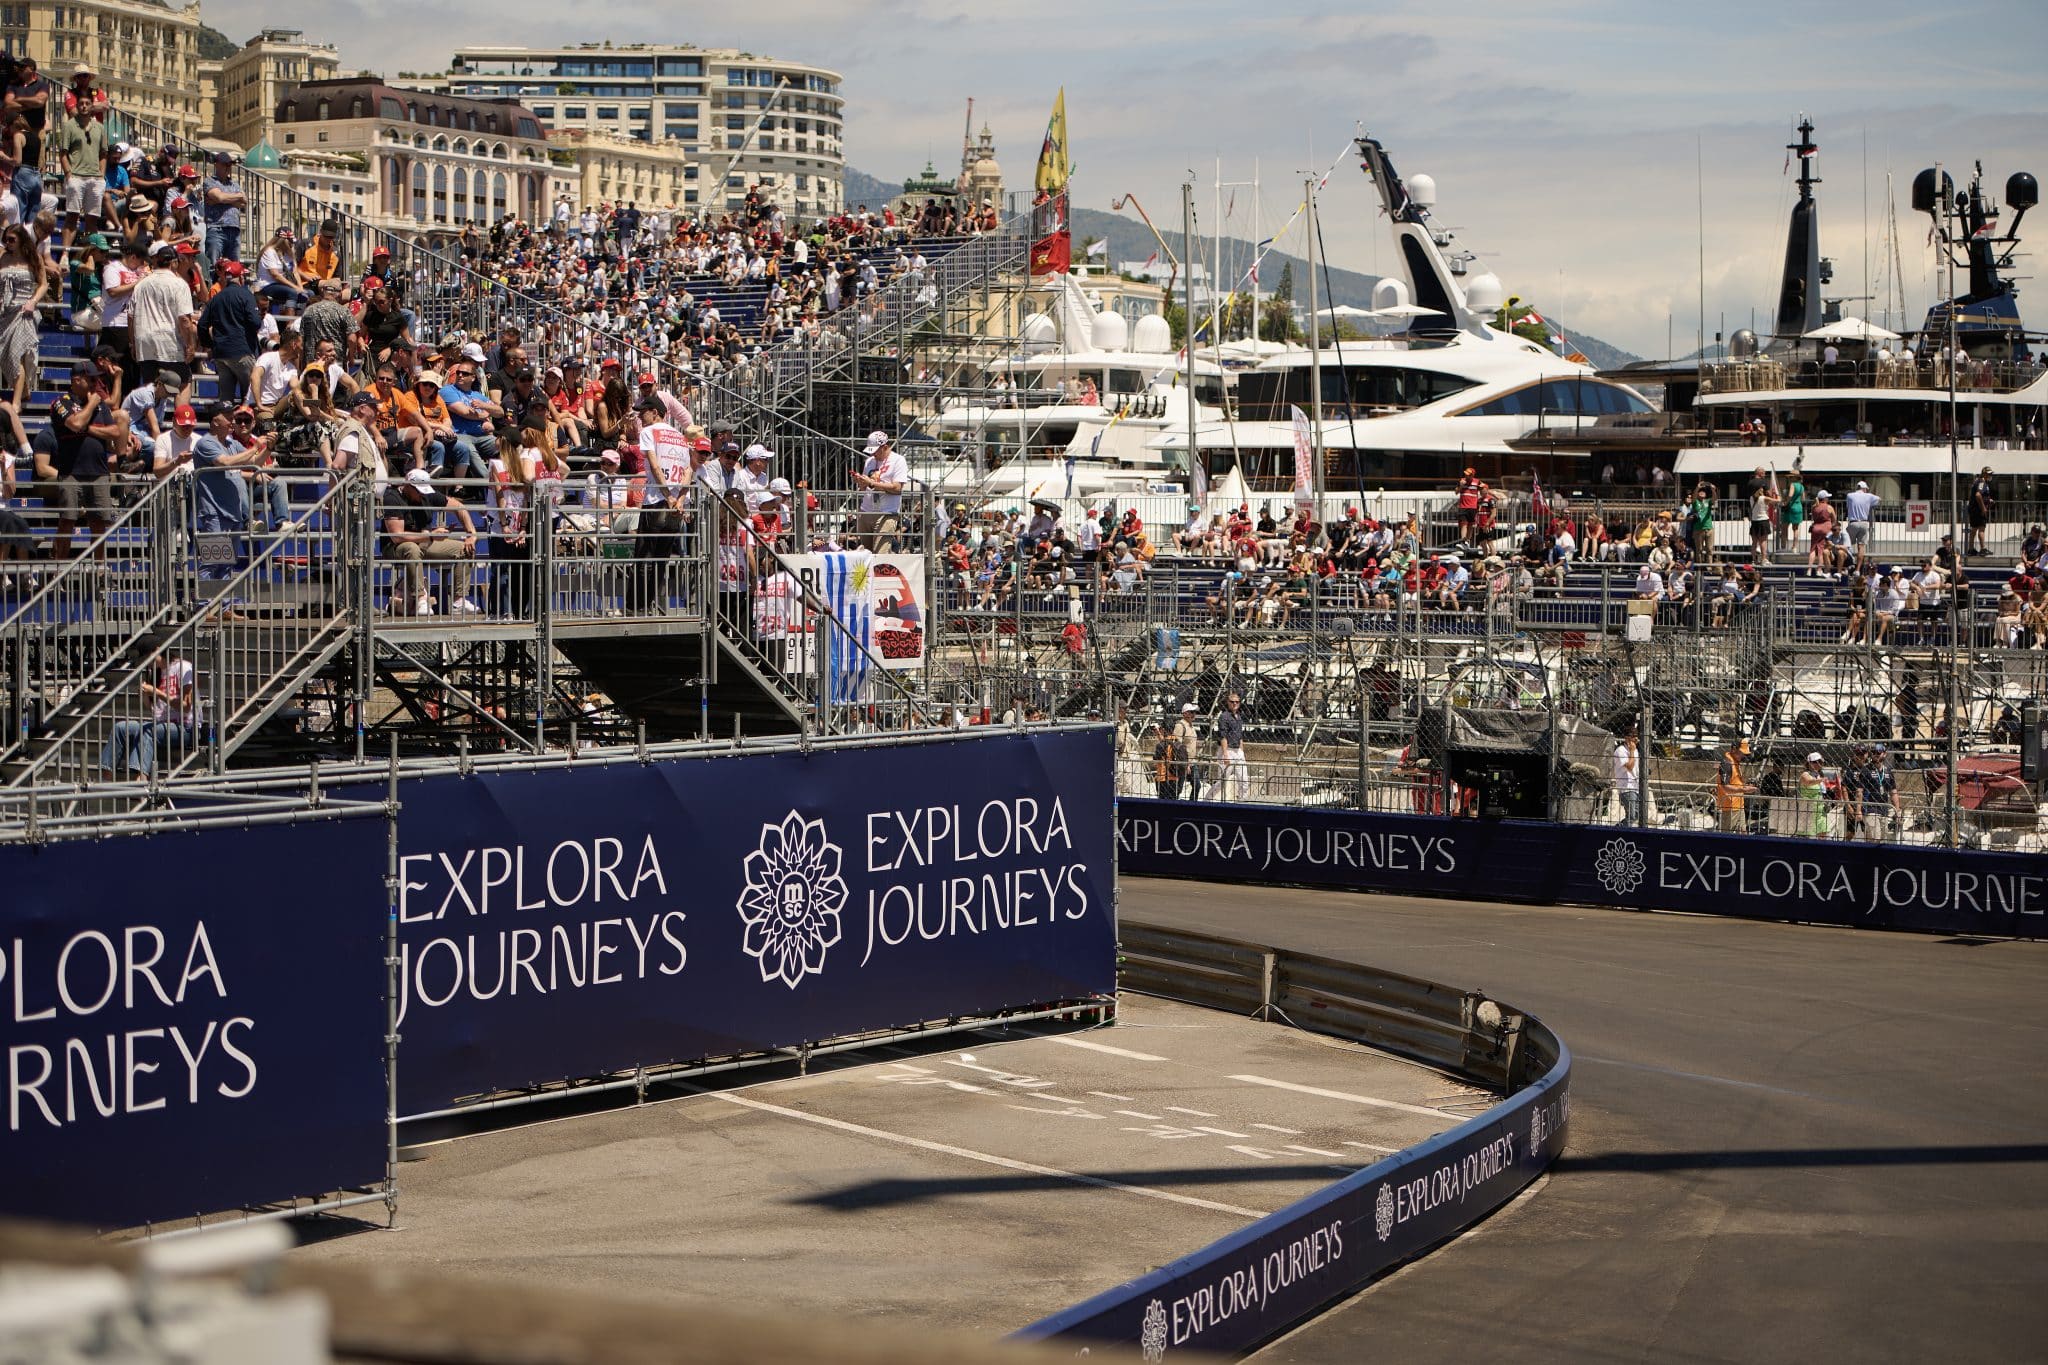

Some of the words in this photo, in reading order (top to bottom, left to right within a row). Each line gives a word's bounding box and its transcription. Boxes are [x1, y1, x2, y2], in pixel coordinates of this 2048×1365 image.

[1911, 513, 1925, 529] P
[400, 834, 667, 923] EXPLORA
[867, 795, 1072, 873] EXPLORA
[1261, 826, 1456, 873] JOURNEYS
[860, 863, 1088, 968] JOURNEYS
[1660, 851, 1856, 902] EXPLORA
[1866, 865, 2045, 915] JOURNE
[0, 920, 227, 1022] LORA
[395, 911, 687, 1029] JOURNEYS
[9, 1017, 257, 1131] RNEYS
[1397, 1163, 1460, 1224] EXPLORA
[1460, 1132, 1513, 1205] JOURNEYS
[1172, 1264, 1258, 1345] EXPLORA
[1261, 1220, 1342, 1312] JOURNEYS
